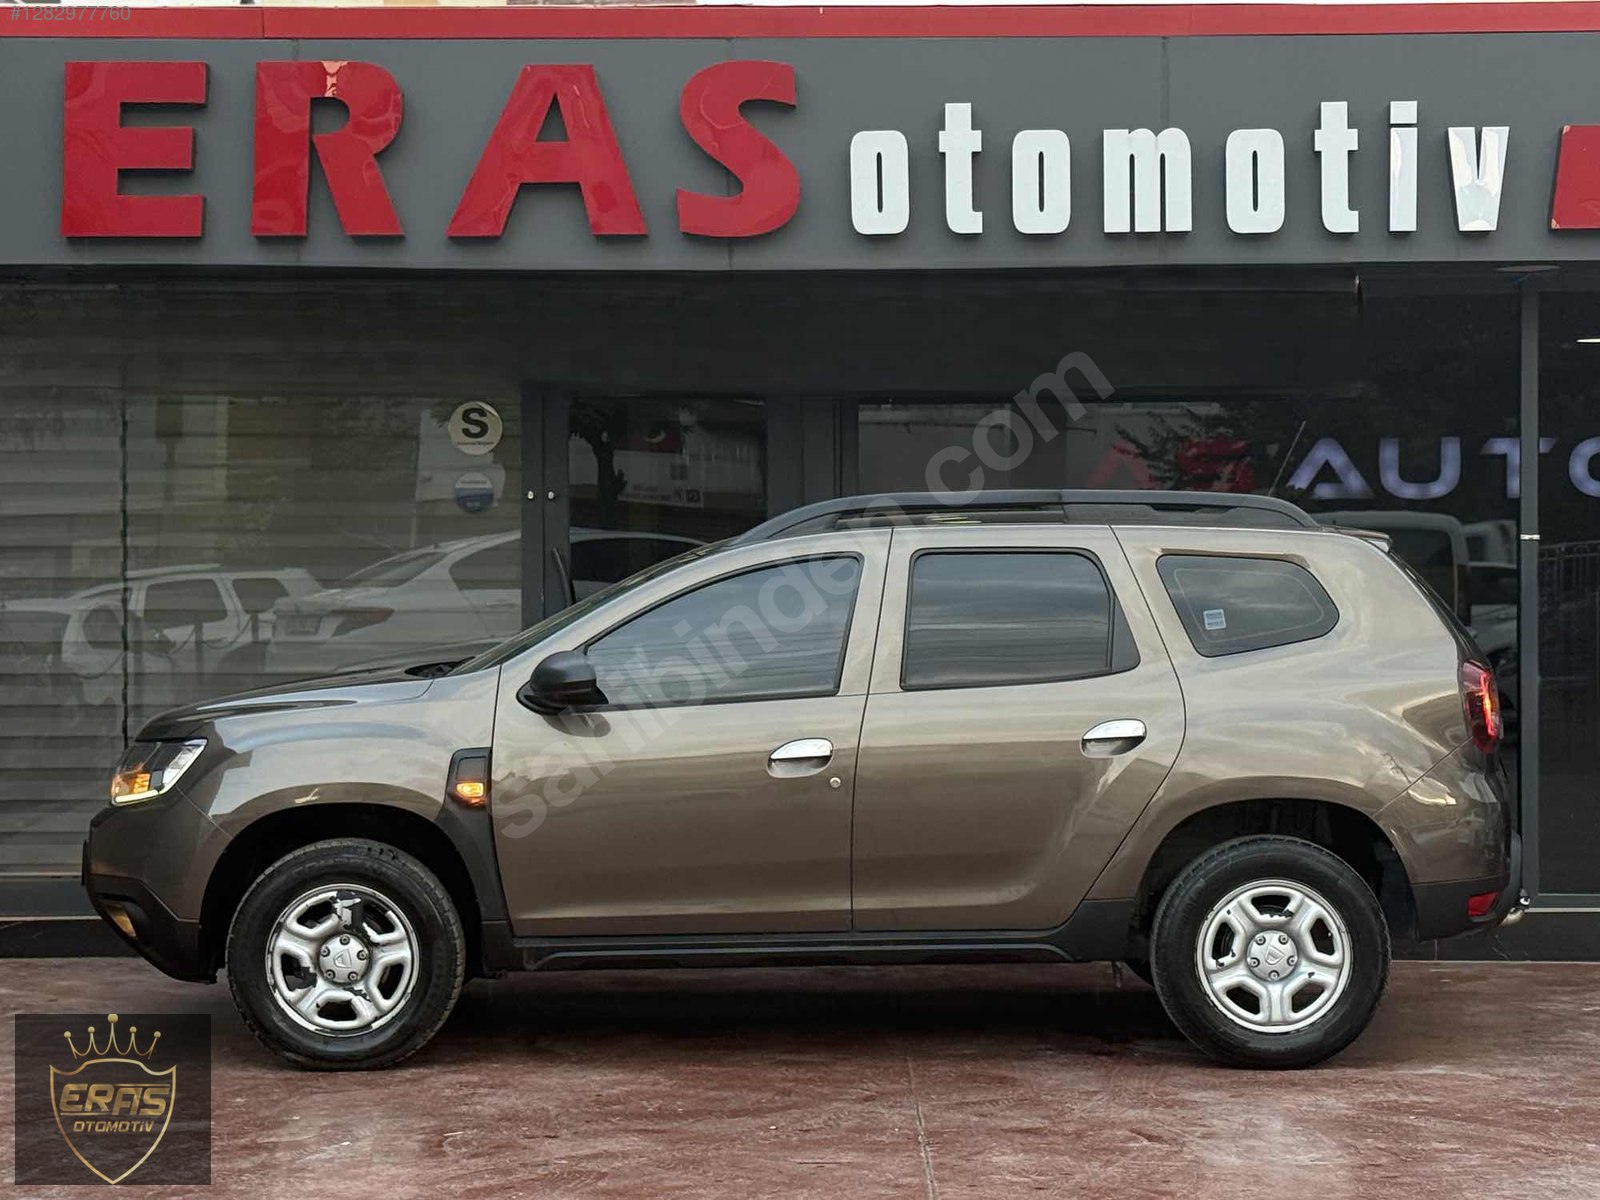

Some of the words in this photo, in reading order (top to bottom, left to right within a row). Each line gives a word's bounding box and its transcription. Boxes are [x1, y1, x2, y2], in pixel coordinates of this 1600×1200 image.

[61, 60, 801, 238] ERAS
[850, 101, 1510, 235] otomotiv
[462, 407, 489, 439] S
